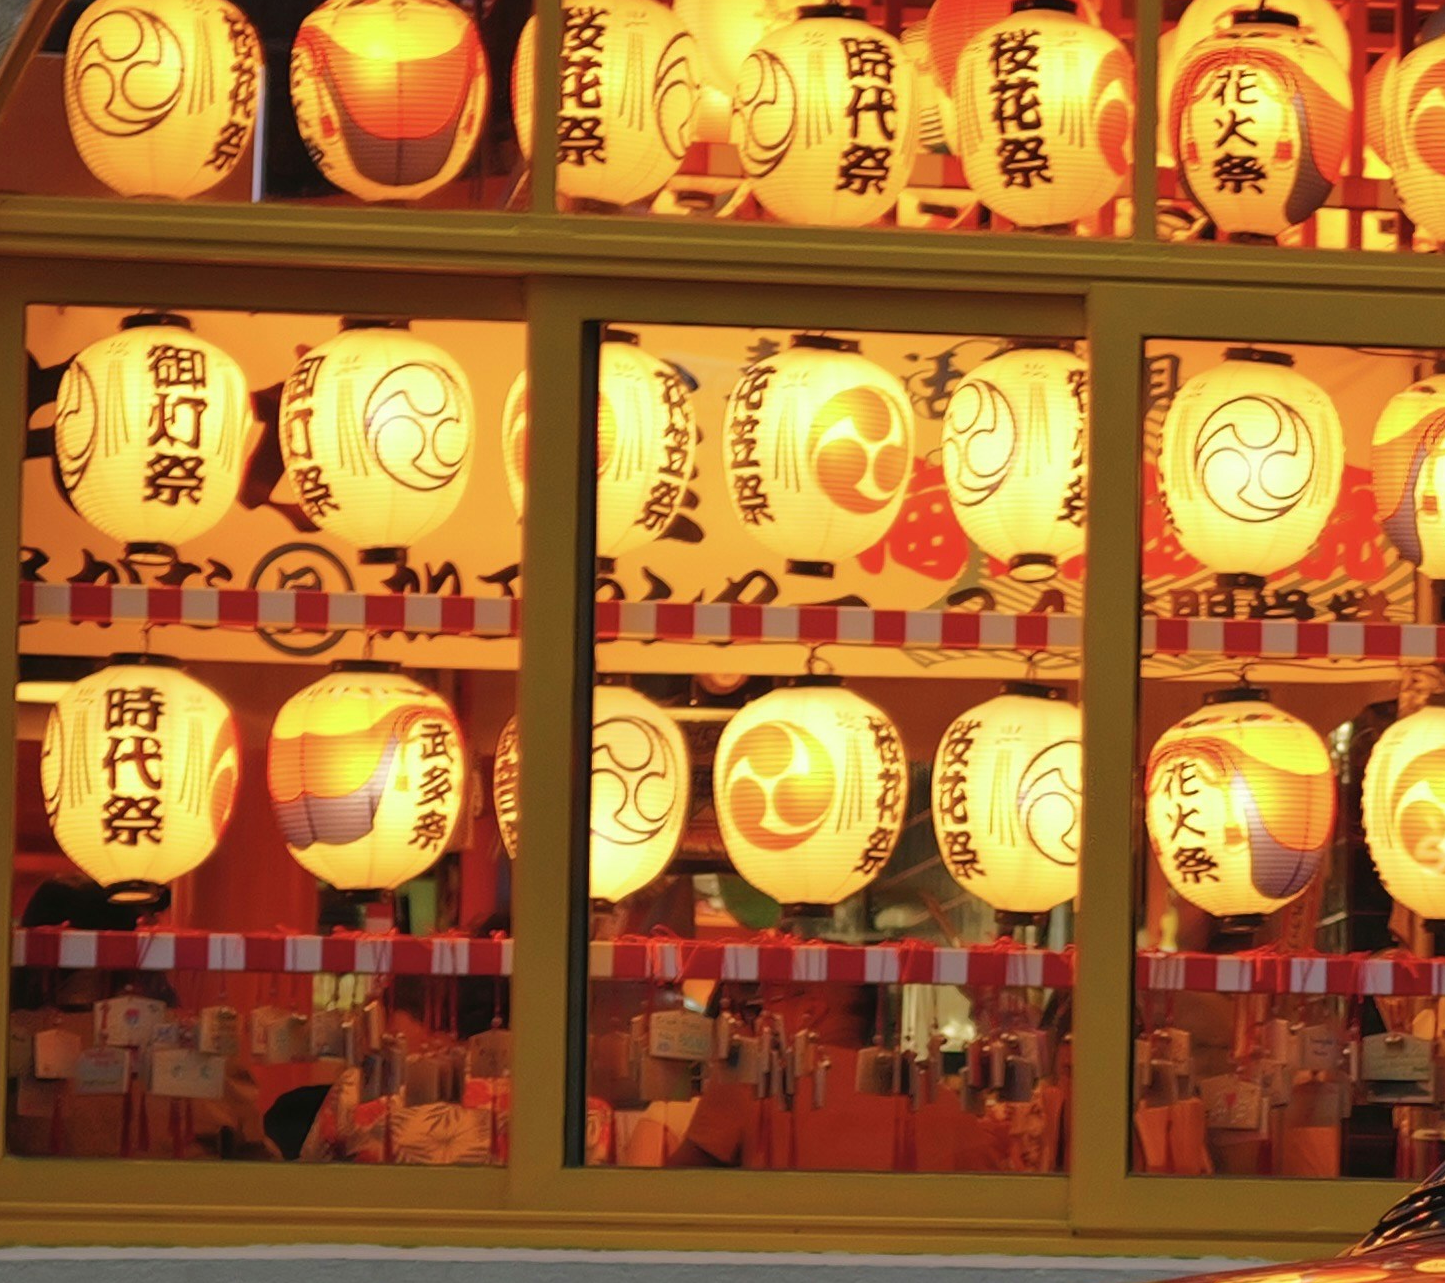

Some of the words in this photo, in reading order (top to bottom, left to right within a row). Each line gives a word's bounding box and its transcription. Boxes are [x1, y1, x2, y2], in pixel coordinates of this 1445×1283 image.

[836, 37, 896, 195] 時代祭
[988, 29, 1052, 189] 桜花祭
[1212, 68, 1267, 195] 花火祭
[143, 344, 208, 505] 御灯祭
[102, 686, 165, 846] 時代祭
[1164, 761, 1220, 883] 花火祭
